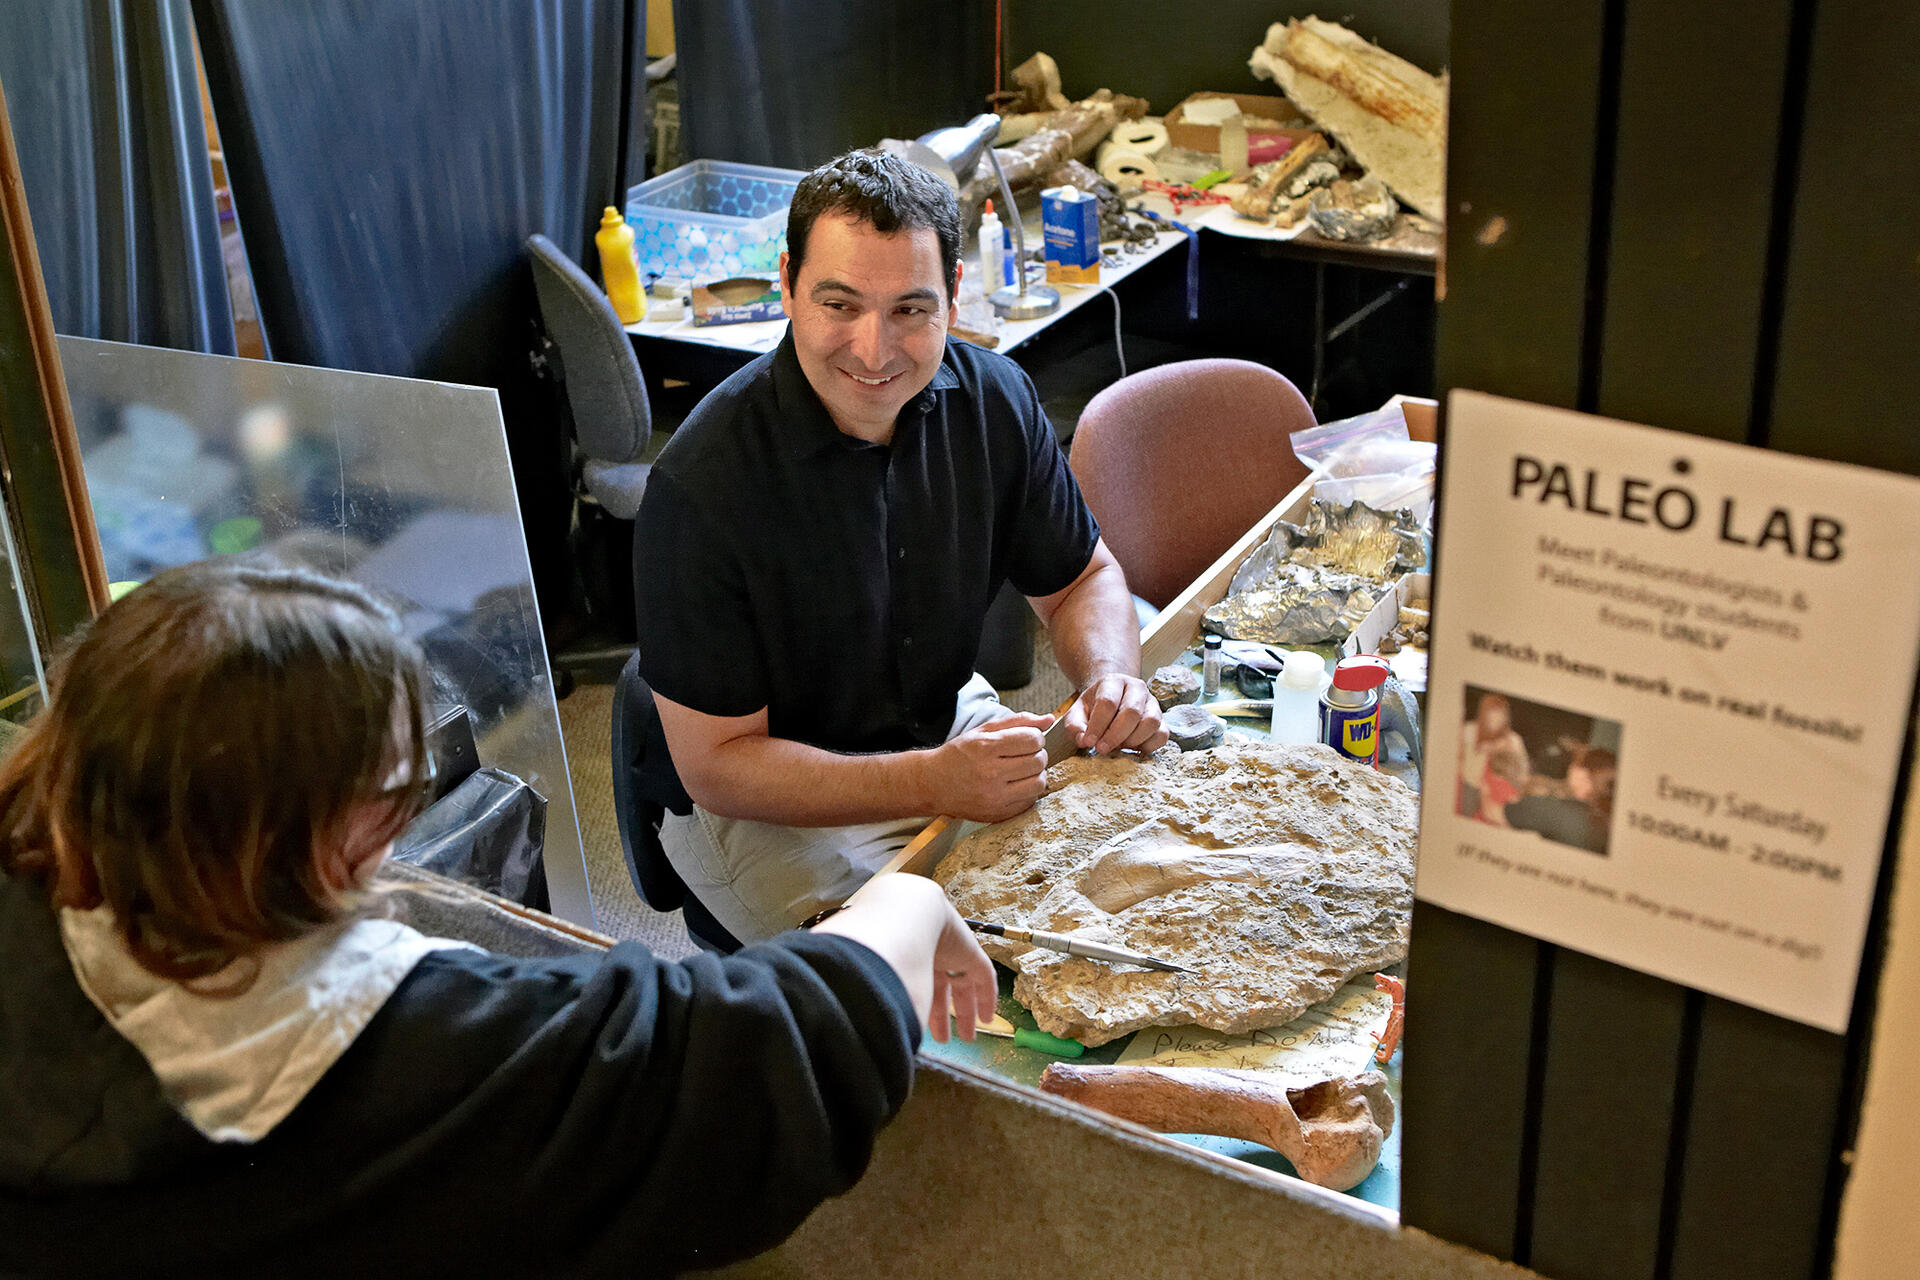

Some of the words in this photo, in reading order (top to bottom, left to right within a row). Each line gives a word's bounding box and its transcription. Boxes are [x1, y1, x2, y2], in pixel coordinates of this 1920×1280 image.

[1511, 455, 1698, 532] PALEO
[1718, 496, 1847, 564] LAB
[1537, 535, 1596, 563] Meet
[1601, 549, 1783, 606] Paleontologists
[1538, 563, 1689, 617] Paleontology
[1696, 603, 1801, 640] students
[1599, 605, 1655, 634] from
[1660, 621, 1730, 651] UNLV
[1467, 631, 1539, 664] Watch
[1544, 650, 1606, 681] them
[1613, 670, 1673, 698] work
[1679, 686, 1712, 708] on
[1717, 695, 1767, 720] real
[1657, 774, 1719, 817] Every
[1724, 791, 1829, 845] Saturday
[1628, 810, 1730, 852] 10:00AM
[1751, 844, 1844, 883] 2:00PM
[1153, 1032, 1230, 1054] Please
[1252, 1029, 1297, 1048] Do
